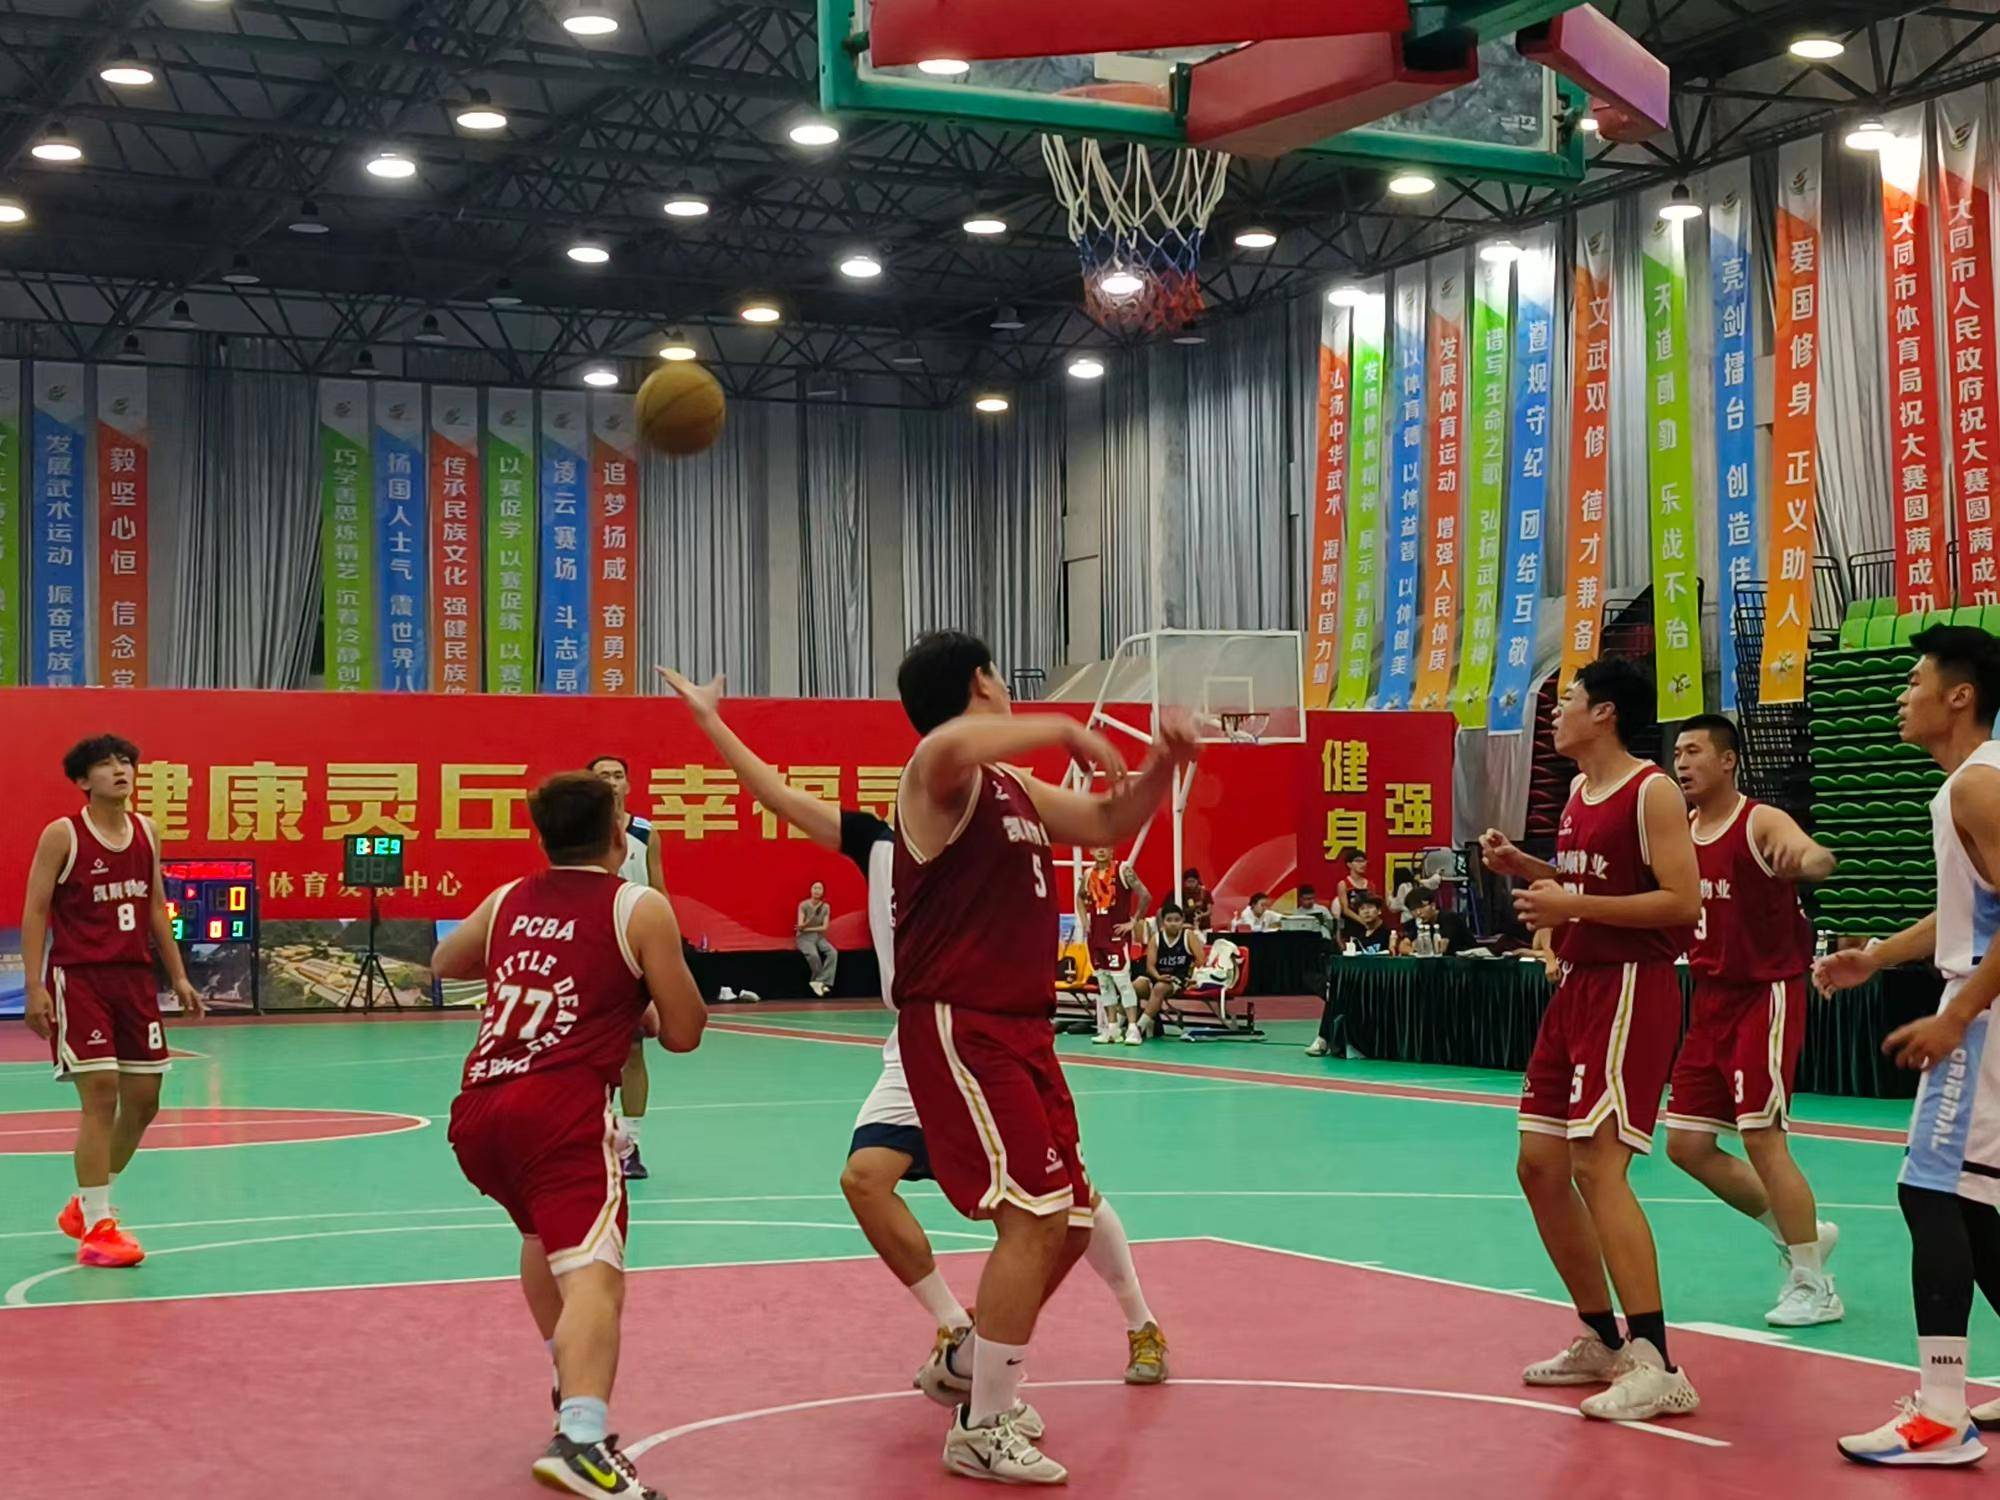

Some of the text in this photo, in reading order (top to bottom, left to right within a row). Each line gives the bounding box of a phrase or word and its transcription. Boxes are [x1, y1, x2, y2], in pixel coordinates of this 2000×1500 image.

[1403, 348, 1421, 448] 以体育德
[1654, 283, 1679, 452] 天道酬勤
[1721, 257, 1745, 431] 亮剑擂台
[499, 456, 523, 540] 以赛促学
[1507, 319, 1548, 668] 遵规守纪 团结互敬
[1573, 296, 1609, 651] 文武双修 德才兼备
[1774, 240, 1814, 630] 爱国修身 正义助人
[47, 434, 73, 567] 发展武术运动
[109, 447, 136, 576] 毅坚心恒
[387, 452, 412, 581] 扬国人士气
[442, 456, 468, 586] 传承民族文化
[1312, 367, 1345, 685] 弘扬中华武术 凝聚中国力量
[1428, 335, 1458, 672] 发展体育运动 增强人民体质
[553, 460, 579, 692] 凌云赛场 斗志昂
[601, 461, 627, 692] 追梦扬威 奋勇争
[1321, 739, 1369, 861] 健身
[117, 903, 136, 931] 8
[229, 886, 246, 911] 0
[509, 914, 577, 942] PCBA
[1032, 853, 1048, 898] 5
[148, 1021, 163, 1050] 8
[492, 984, 554, 1040] 77
[1569, 1063, 1586, 1104] 5
[1733, 1070, 1745, 1104] 3
[1930, 1354, 1964, 1366] NBA
